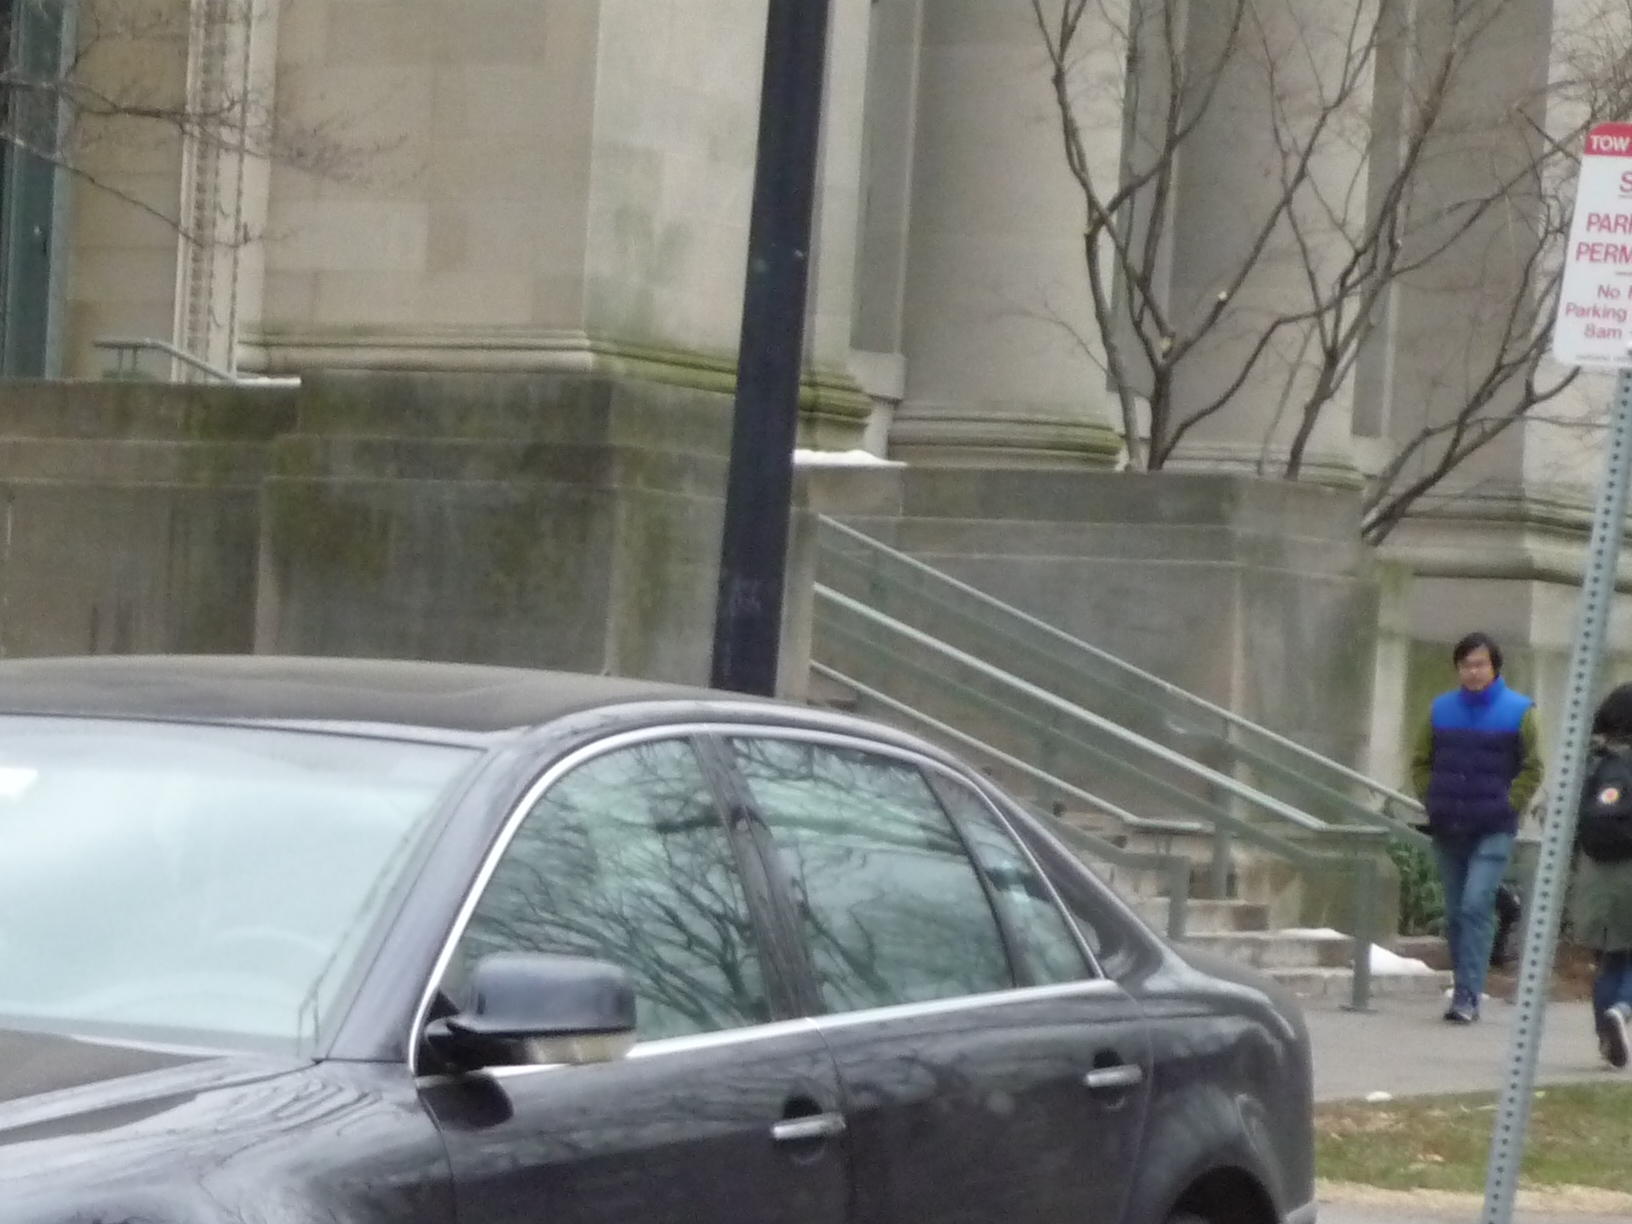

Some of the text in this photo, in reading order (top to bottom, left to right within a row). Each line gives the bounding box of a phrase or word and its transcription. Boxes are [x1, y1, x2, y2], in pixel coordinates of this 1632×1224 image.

[1590, 135, 1630, 152] TOW
[1586, 212, 1632, 234] PAR
[1597, 284, 1621, 299] No
[1565, 302, 1628, 322] Parking
[1583, 323, 1623, 339] 8am
